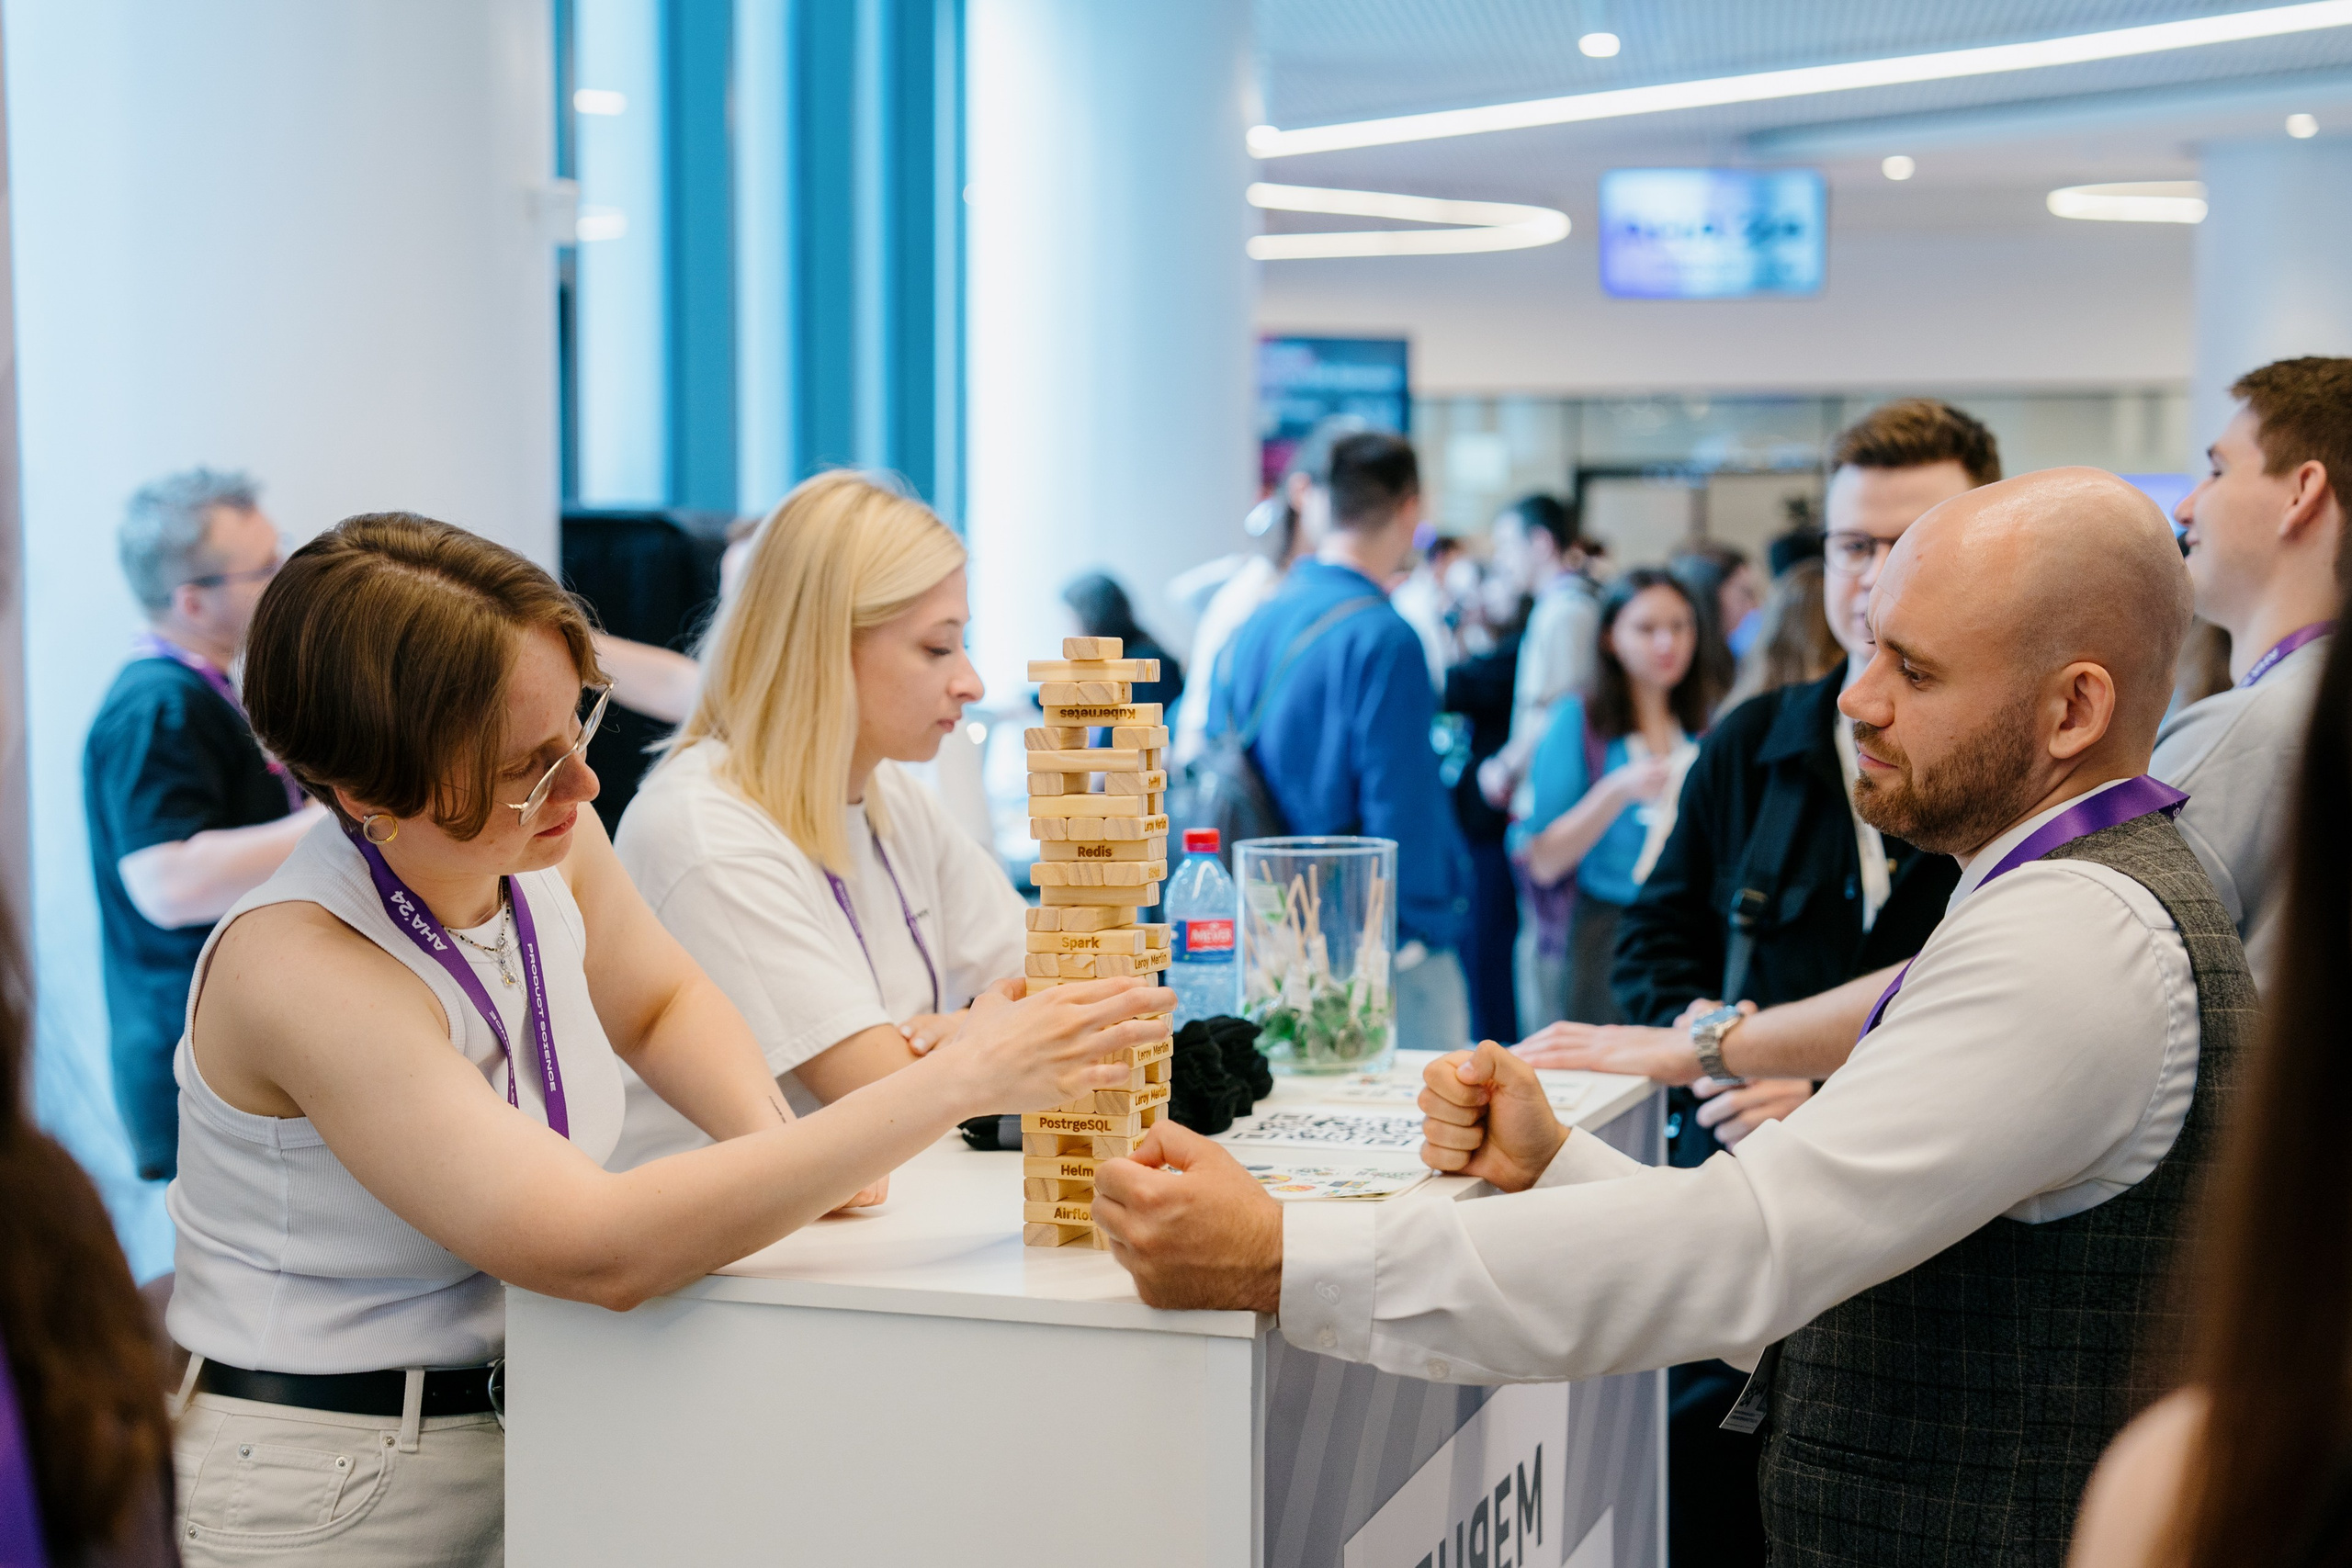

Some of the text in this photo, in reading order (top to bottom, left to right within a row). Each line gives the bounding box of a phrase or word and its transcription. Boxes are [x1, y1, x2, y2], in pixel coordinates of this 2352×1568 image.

[1059, 707, 1136, 720] Kubernetes
[1077, 845, 1113, 858] Redis
[1061, 936, 1100, 951] Spark
[1134, 953, 1168, 970] Leroy Merlin
[526, 942, 557, 1092] PRODUCT SCIENCE
[1137, 1042, 1170, 1062] Leroy Merlin
[1135, 1084, 1168, 1106] Leroy Merlin
[1039, 1117, 1112, 1133] PostrgeSQL
[1060, 1164, 1093, 1178] Helm
